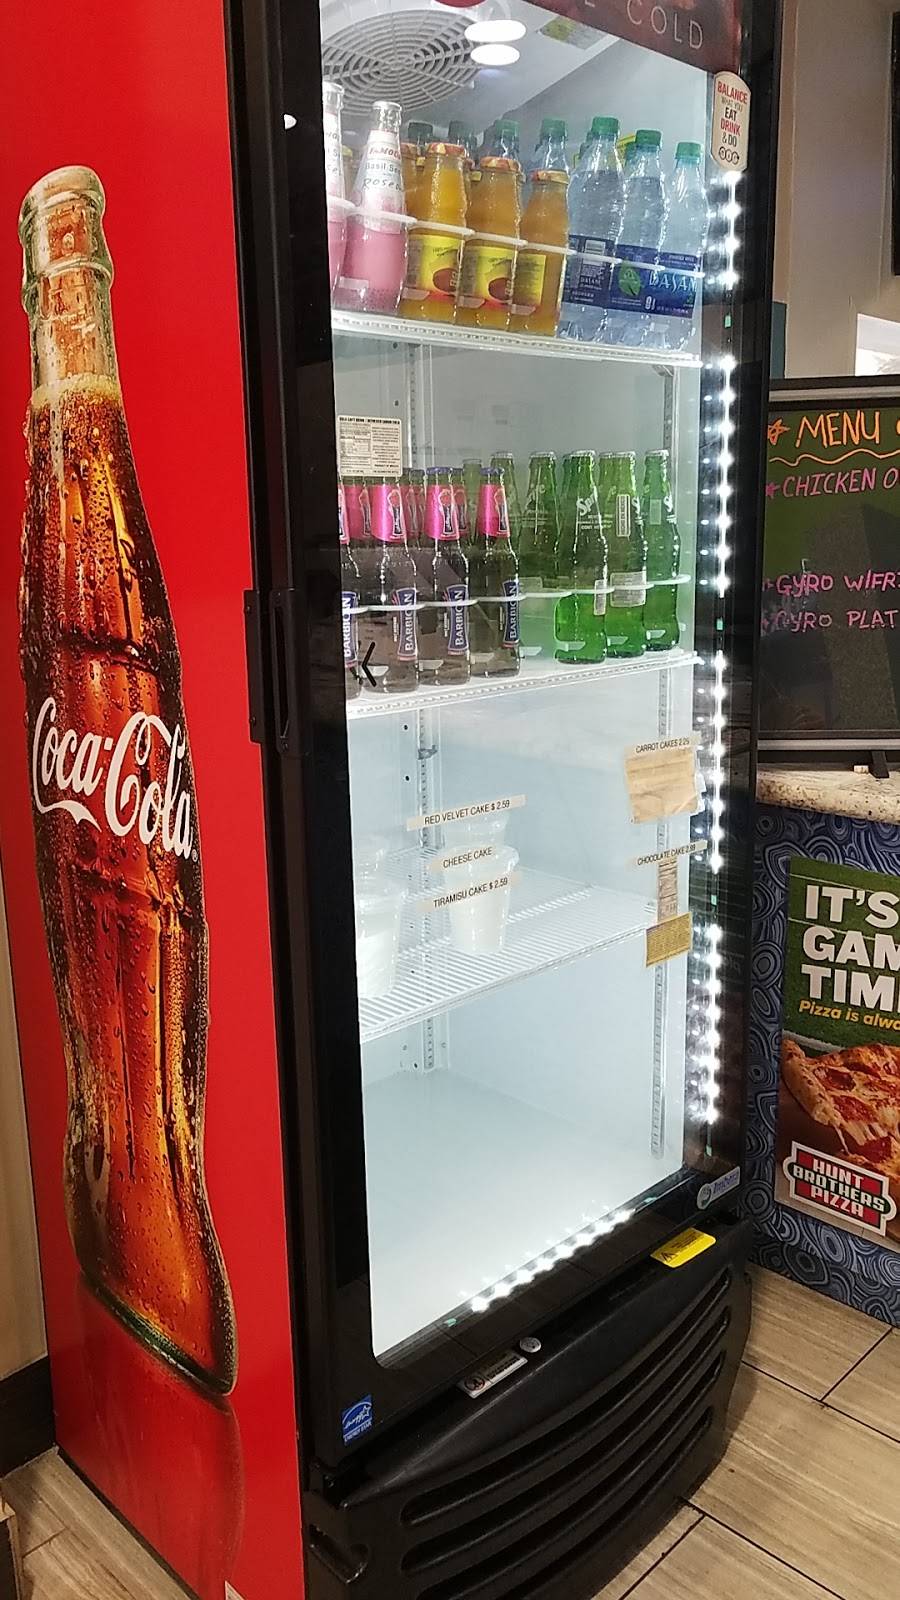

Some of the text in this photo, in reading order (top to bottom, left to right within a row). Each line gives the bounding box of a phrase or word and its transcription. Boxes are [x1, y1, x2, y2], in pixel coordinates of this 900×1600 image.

[626, 0, 703, 49] COLD
[717, 81, 748, 104] BALANCE
[720, 118, 741, 136] DRINK
[724, 107, 737, 121] EAT
[728, 135, 737, 147] DO
[796, 410, 880, 448] MENU
[783, 468, 877, 498] CHICKEN
[776, 573, 834, 598] GYRO
[341, 597, 352, 658] BARBICN
[404, 593, 414, 651] BARBICN
[454, 590, 464, 646] BARBICN
[509, 585, 518, 639] BARBICN
[846, 610, 899, 629] PLAT
[635, 742, 659, 754] CARROT
[659, 739, 678, 750] CAKES
[33, 697, 193, 859] Coca-Cola
[424, 799, 510, 825] RED VELVET CAKE $ 2.59
[442, 846, 493, 869] CHEESE CAKE
[637, 849, 670, 866] CHOCOLATE
[670, 846, 686, 857] CAKE
[433, 877, 508, 908] TIRAMISU CAKE $ 2.59
[805, 884, 900, 929] IT'S
[801, 963, 900, 1014] TIM
[799, 1000, 842, 1020] Pizza
[845, 1008, 859, 1022] is
[793, 1164, 885, 1212] BROTHERS
[813, 1158, 864, 1189] HUNT
[810, 1185, 864, 1218] PIZZA
